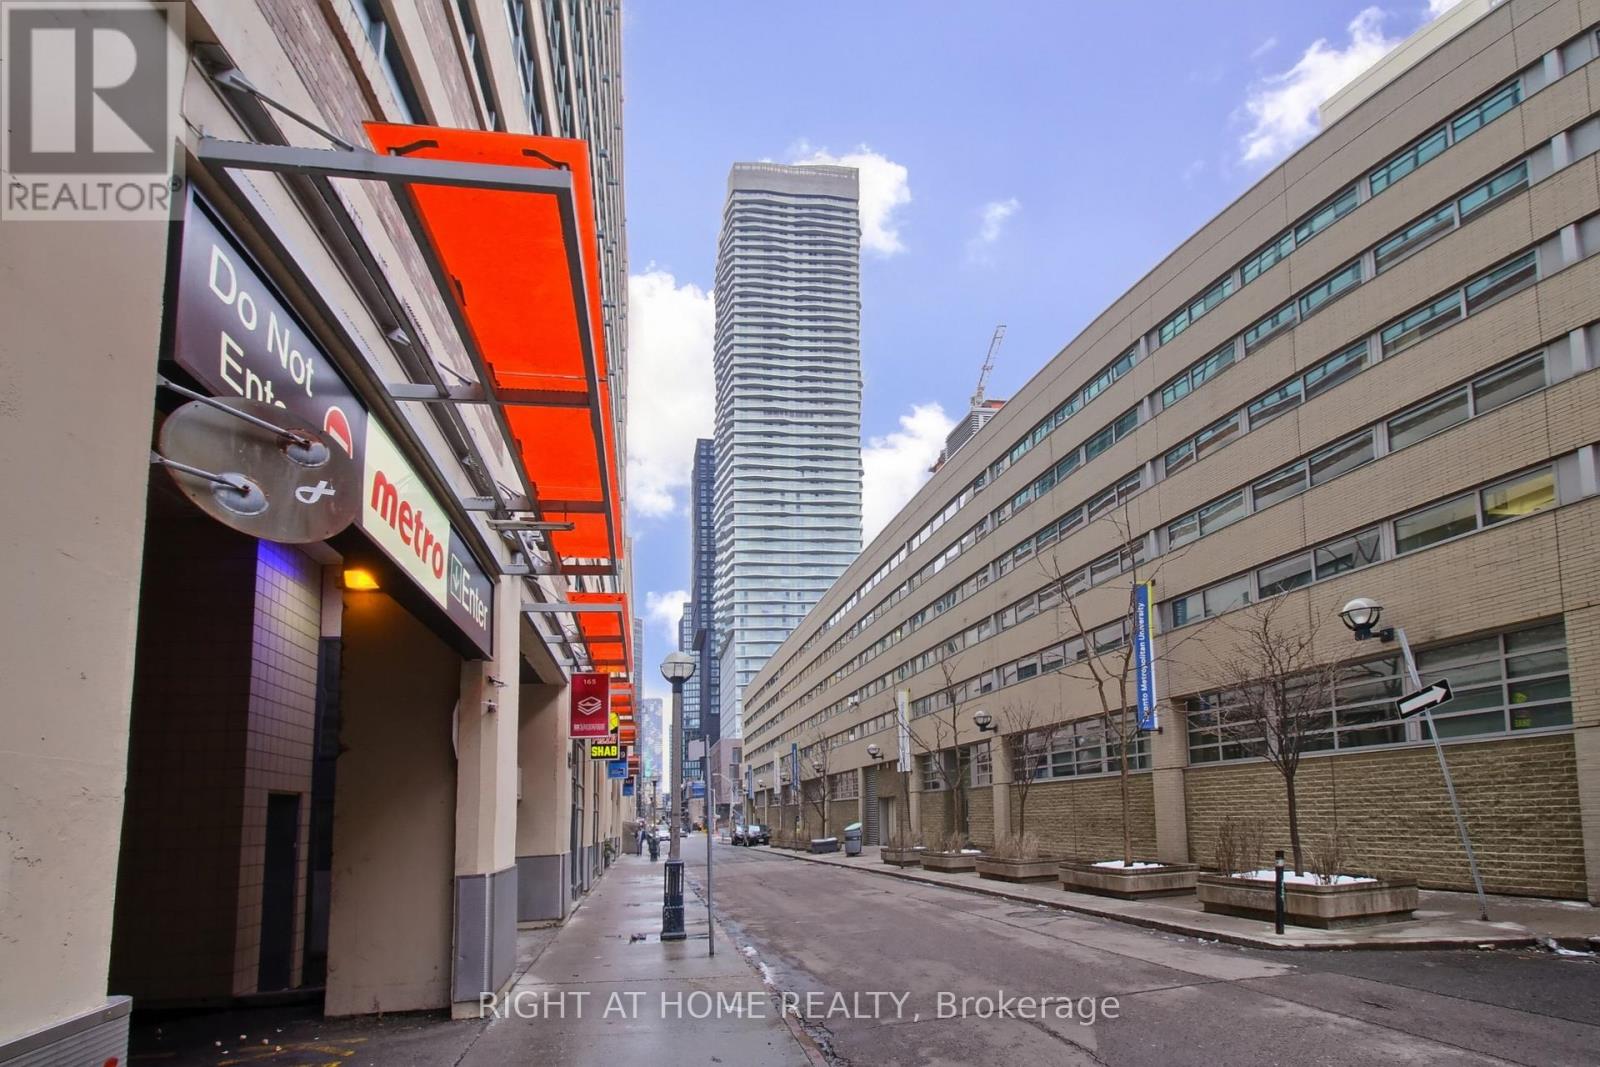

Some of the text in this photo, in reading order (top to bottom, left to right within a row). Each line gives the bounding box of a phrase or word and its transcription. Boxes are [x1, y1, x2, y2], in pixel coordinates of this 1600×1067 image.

[209, 244, 314, 397] Do Not
[220, 331, 287, 409] Ent
[371, 471, 444, 579] metro
[461, 572, 489, 631] Enter
[1137, 603, 1145, 640] University
[591, 745, 617, 757] SHAB
